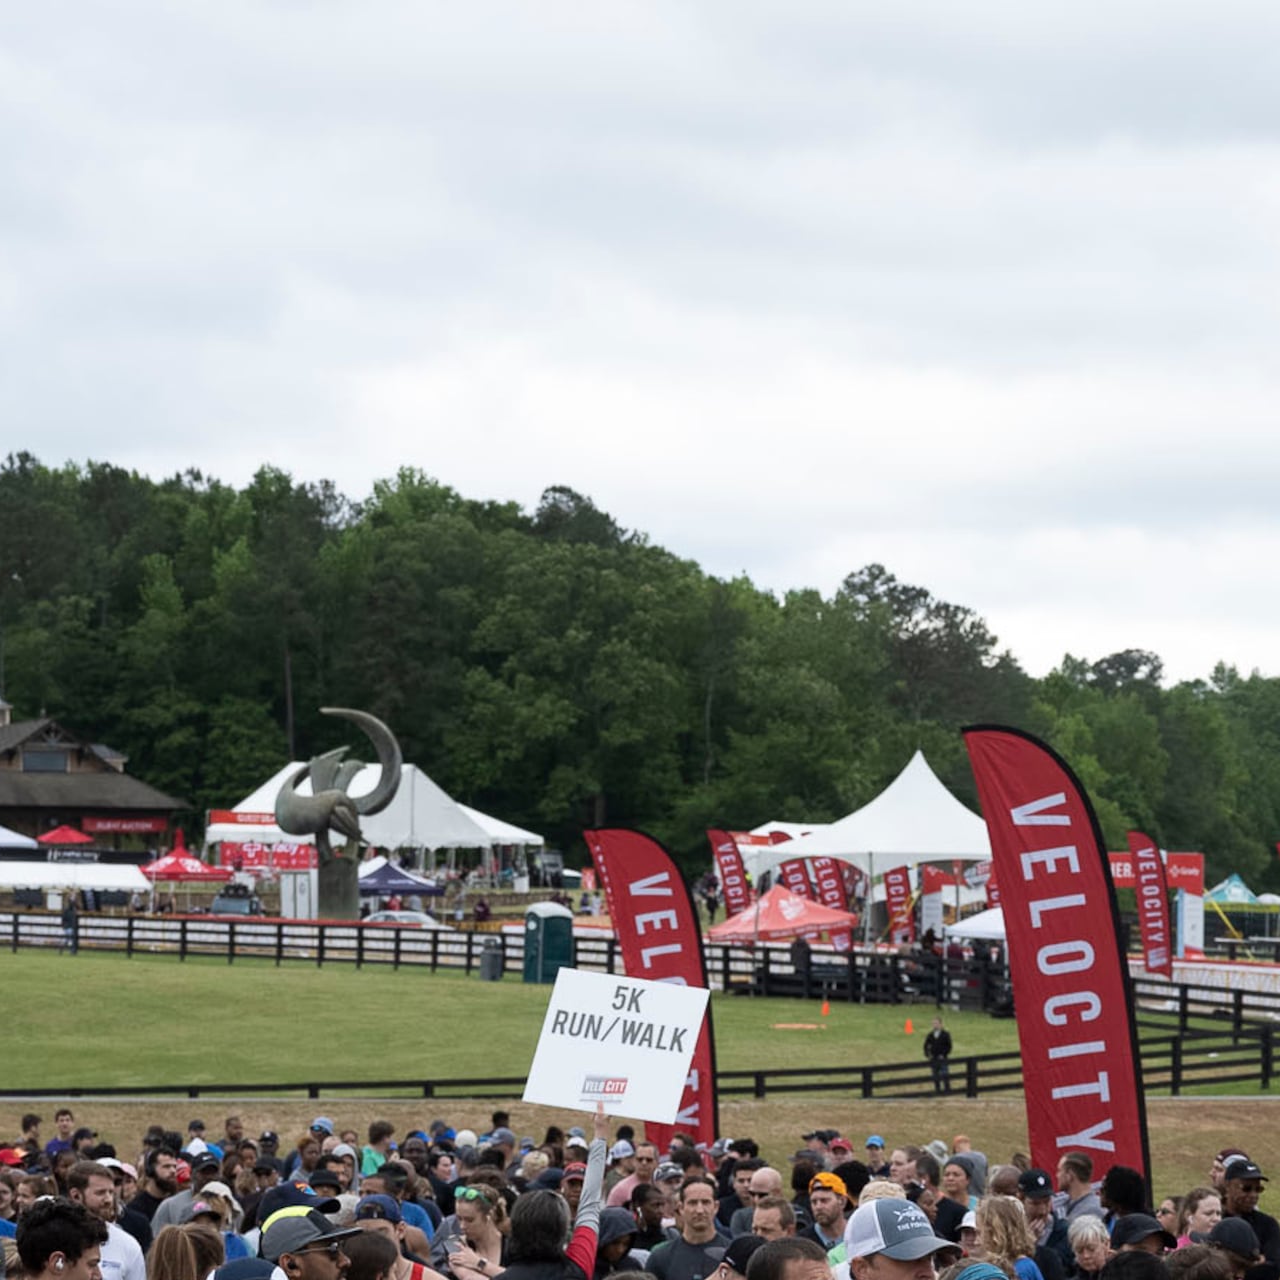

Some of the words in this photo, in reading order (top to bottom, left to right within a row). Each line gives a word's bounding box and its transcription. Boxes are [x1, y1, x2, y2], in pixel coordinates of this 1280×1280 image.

[1136, 847, 1166, 943] VELOCITY
[611, 985, 646, 1013] 5K
[628, 871, 700, 1127] VELTY
[1010, 792, 1116, 1153] VELOCITY
[551, 1009, 688, 1053] RUN/WALK
